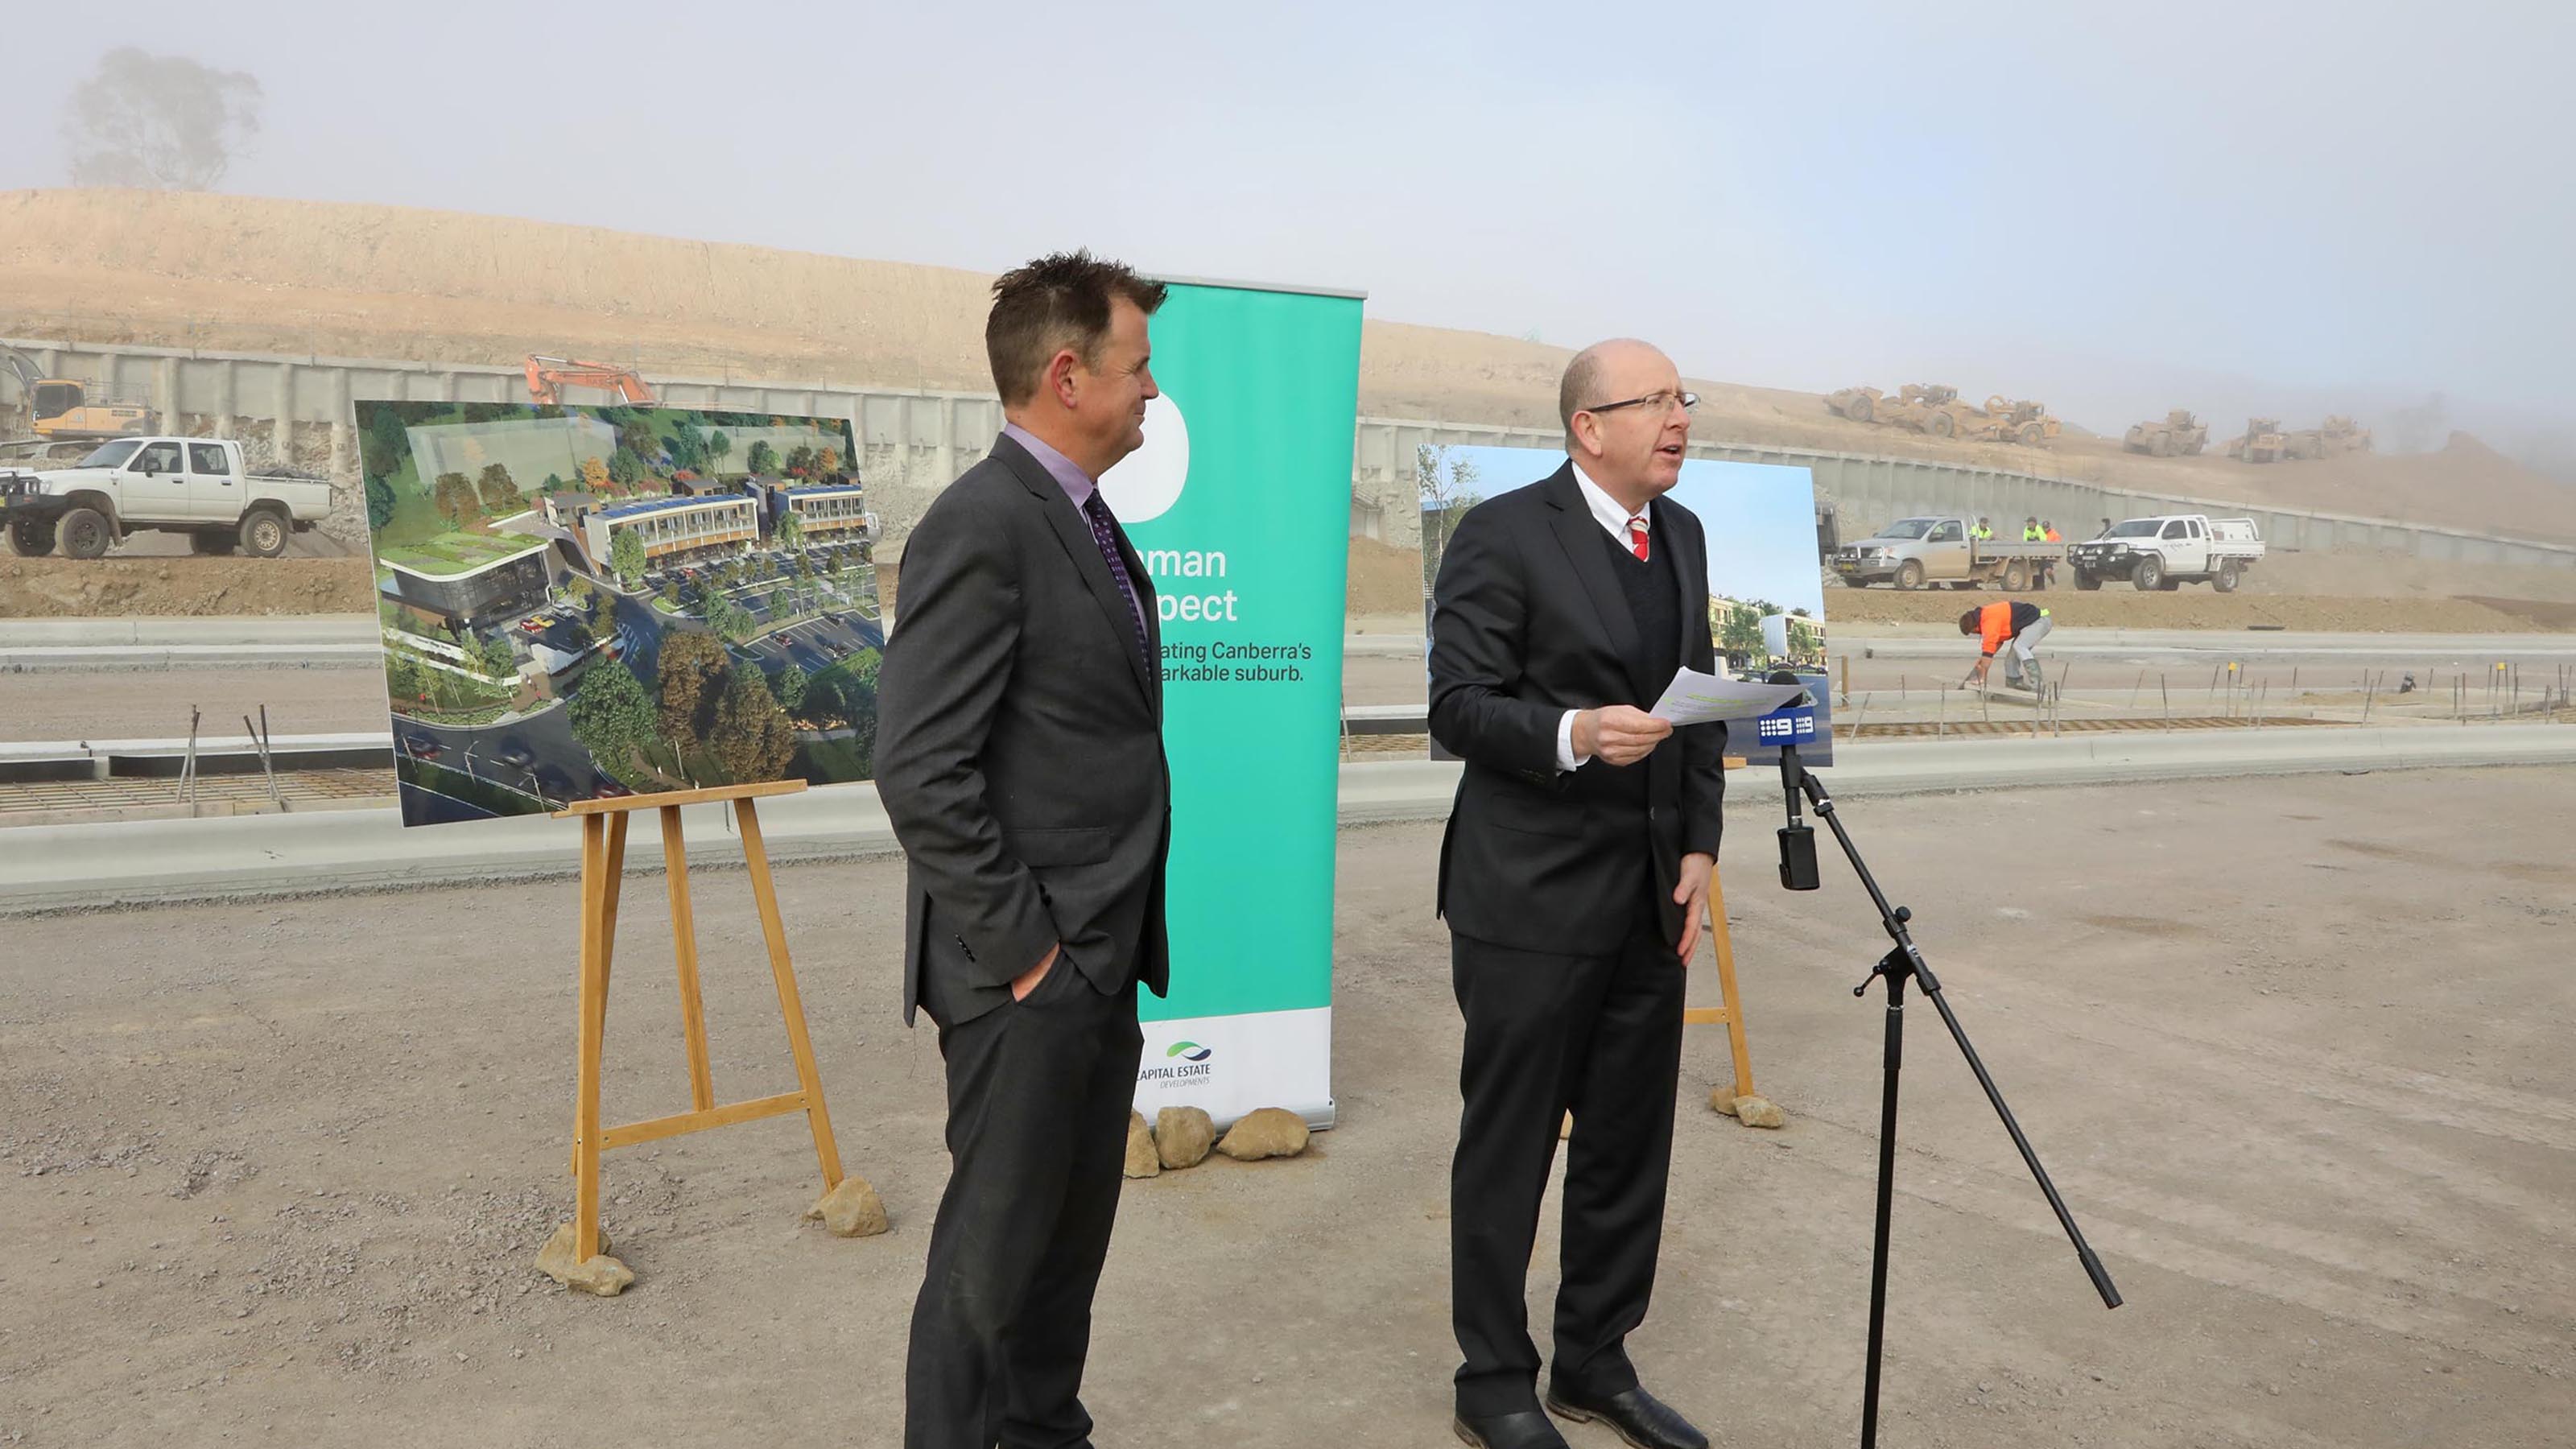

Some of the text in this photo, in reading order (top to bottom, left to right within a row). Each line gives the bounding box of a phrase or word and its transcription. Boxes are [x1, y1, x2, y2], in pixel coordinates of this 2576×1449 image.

[1212, 642, 1311, 659] Canberra's
[1235, 665, 1303, 681] suburb.
[1178, 1063, 1211, 1077] ESTATE
[1160, 1076, 1211, 1089] DEVELOPMENTS
